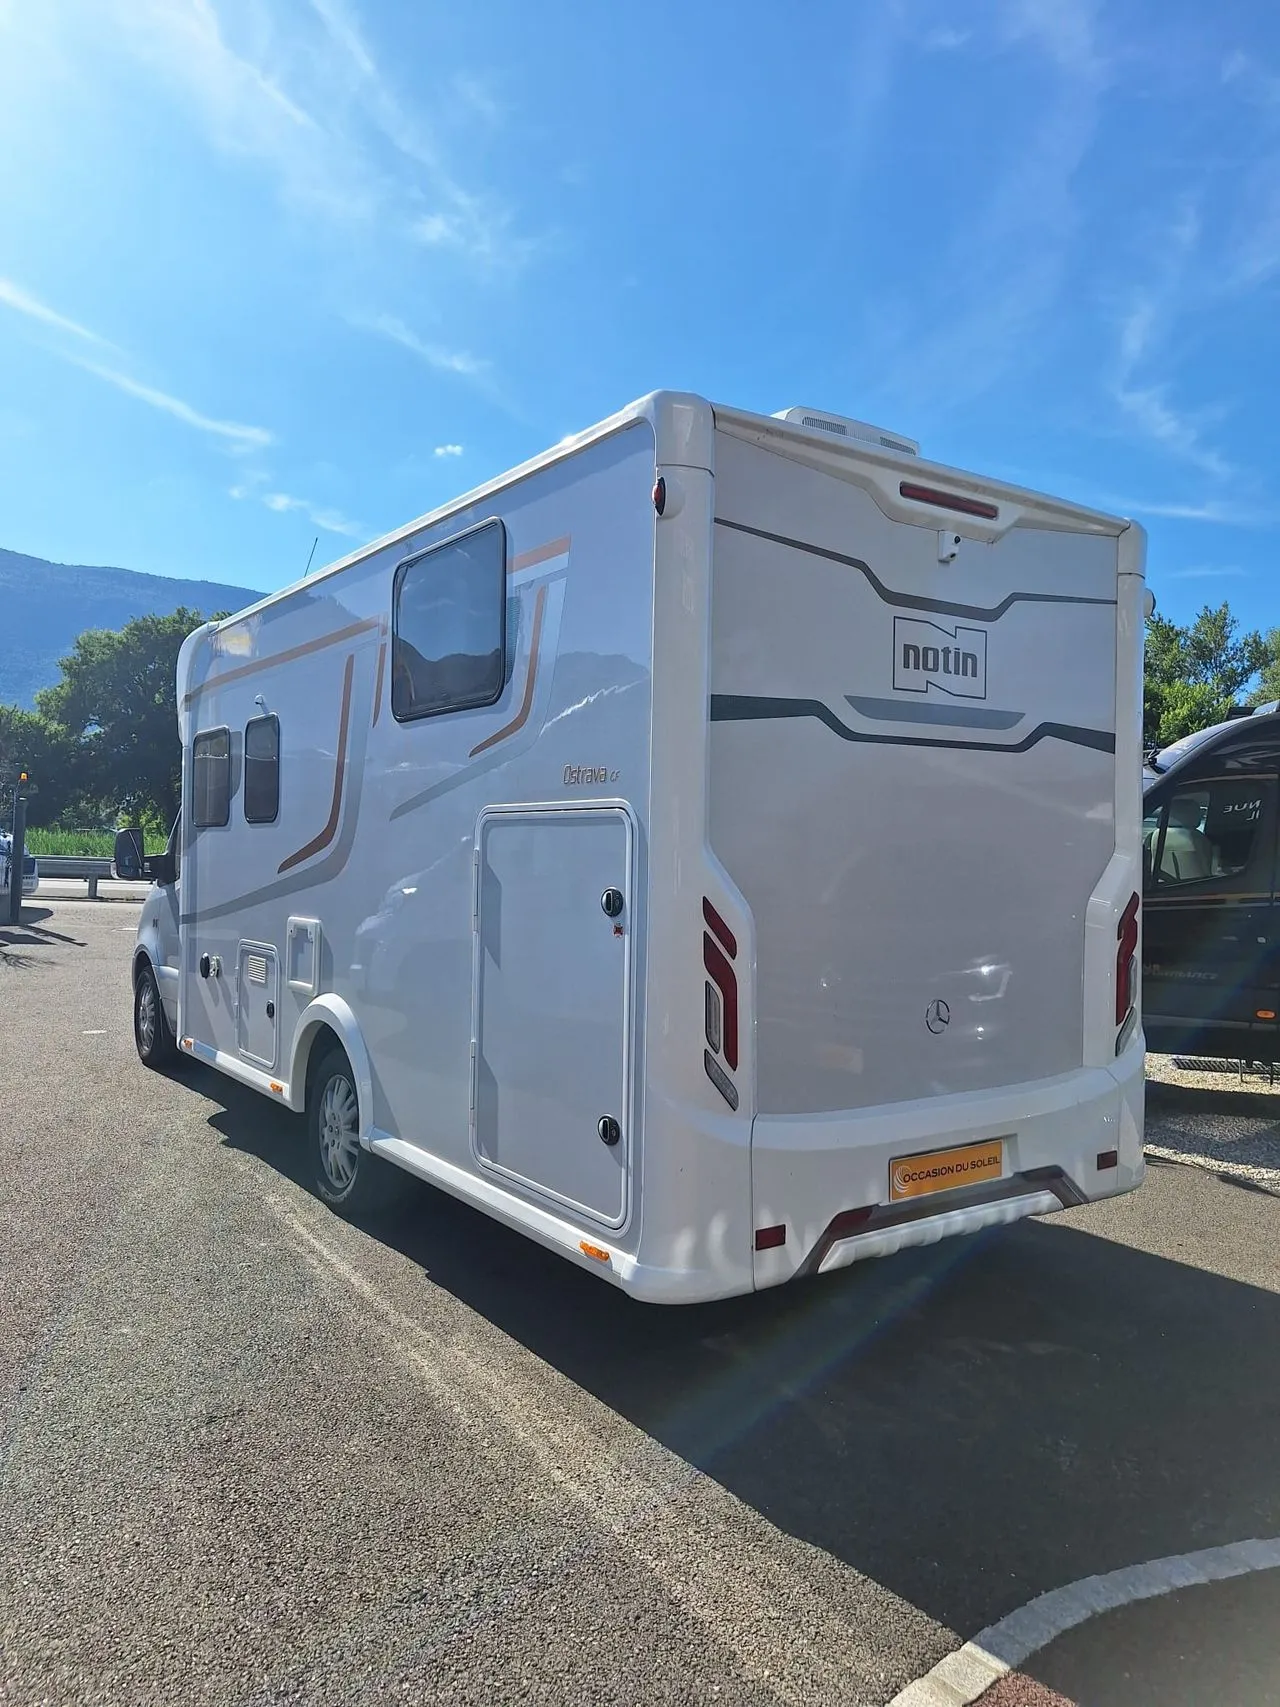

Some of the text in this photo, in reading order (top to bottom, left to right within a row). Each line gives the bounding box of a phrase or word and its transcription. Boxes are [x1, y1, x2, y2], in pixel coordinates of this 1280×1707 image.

[903, 643, 978, 678] notin
[563, 763, 607, 785] Ostrava
[902, 1156, 1001, 1183] OCCASION DU SOLEIL
